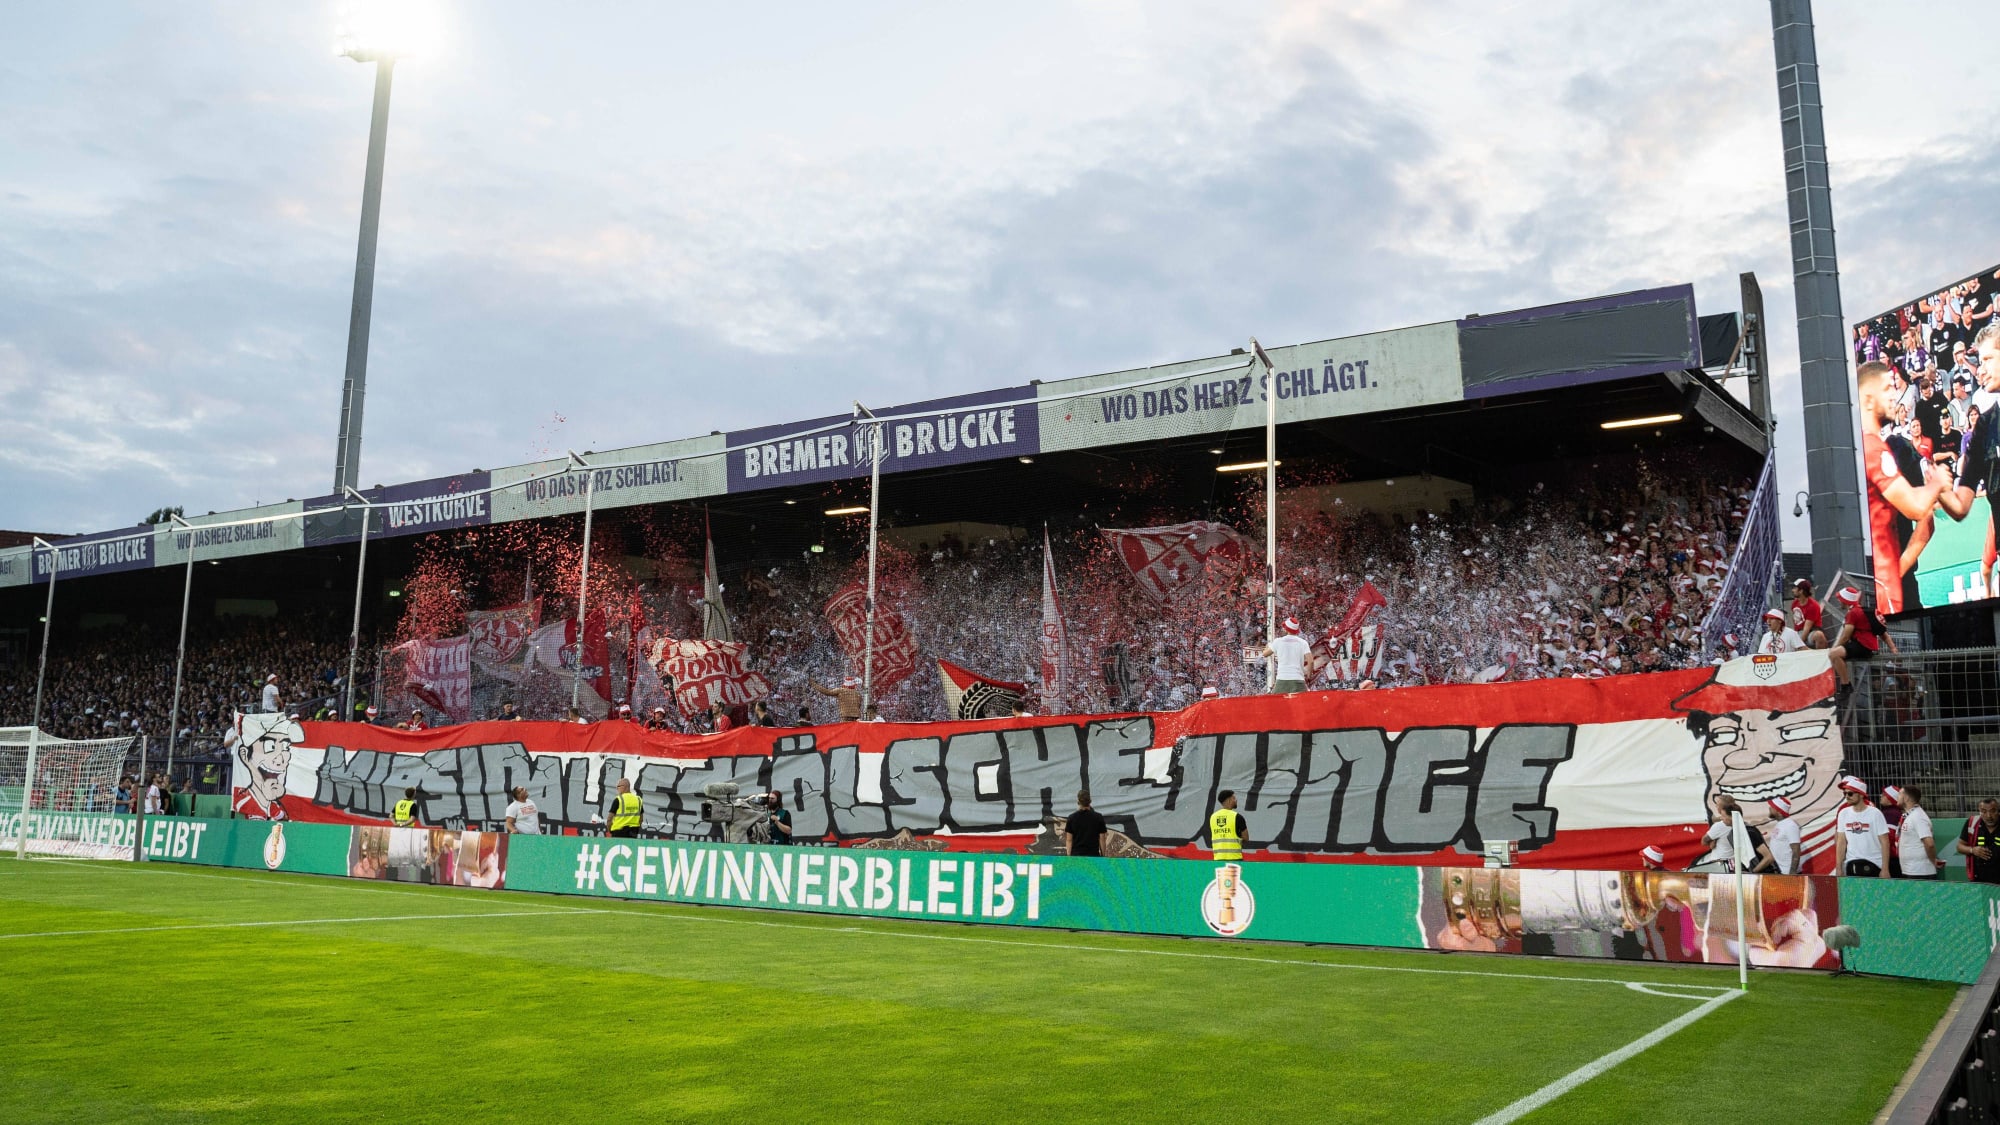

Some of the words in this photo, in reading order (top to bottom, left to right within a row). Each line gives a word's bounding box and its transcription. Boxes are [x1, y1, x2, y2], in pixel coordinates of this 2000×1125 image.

[1101, 393, 1138, 423] WO
[1143, 386, 1189, 418] DAS
[1194, 377, 1254, 412] HERZ
[1260, 359, 1378, 401] SCHLÄGT.
[745, 434, 849, 478] BREMER
[896, 408, 1016, 458] BRÜCKE
[388, 488, 486, 528] WESTKURVE
[526, 480, 545, 501] WO
[549, 475, 575, 498] DAS
[579, 469, 613, 495] HRZ
[212, 525, 233, 545] HERZ
[575, 843, 1053, 920] #GEWINNERBLEIBT
